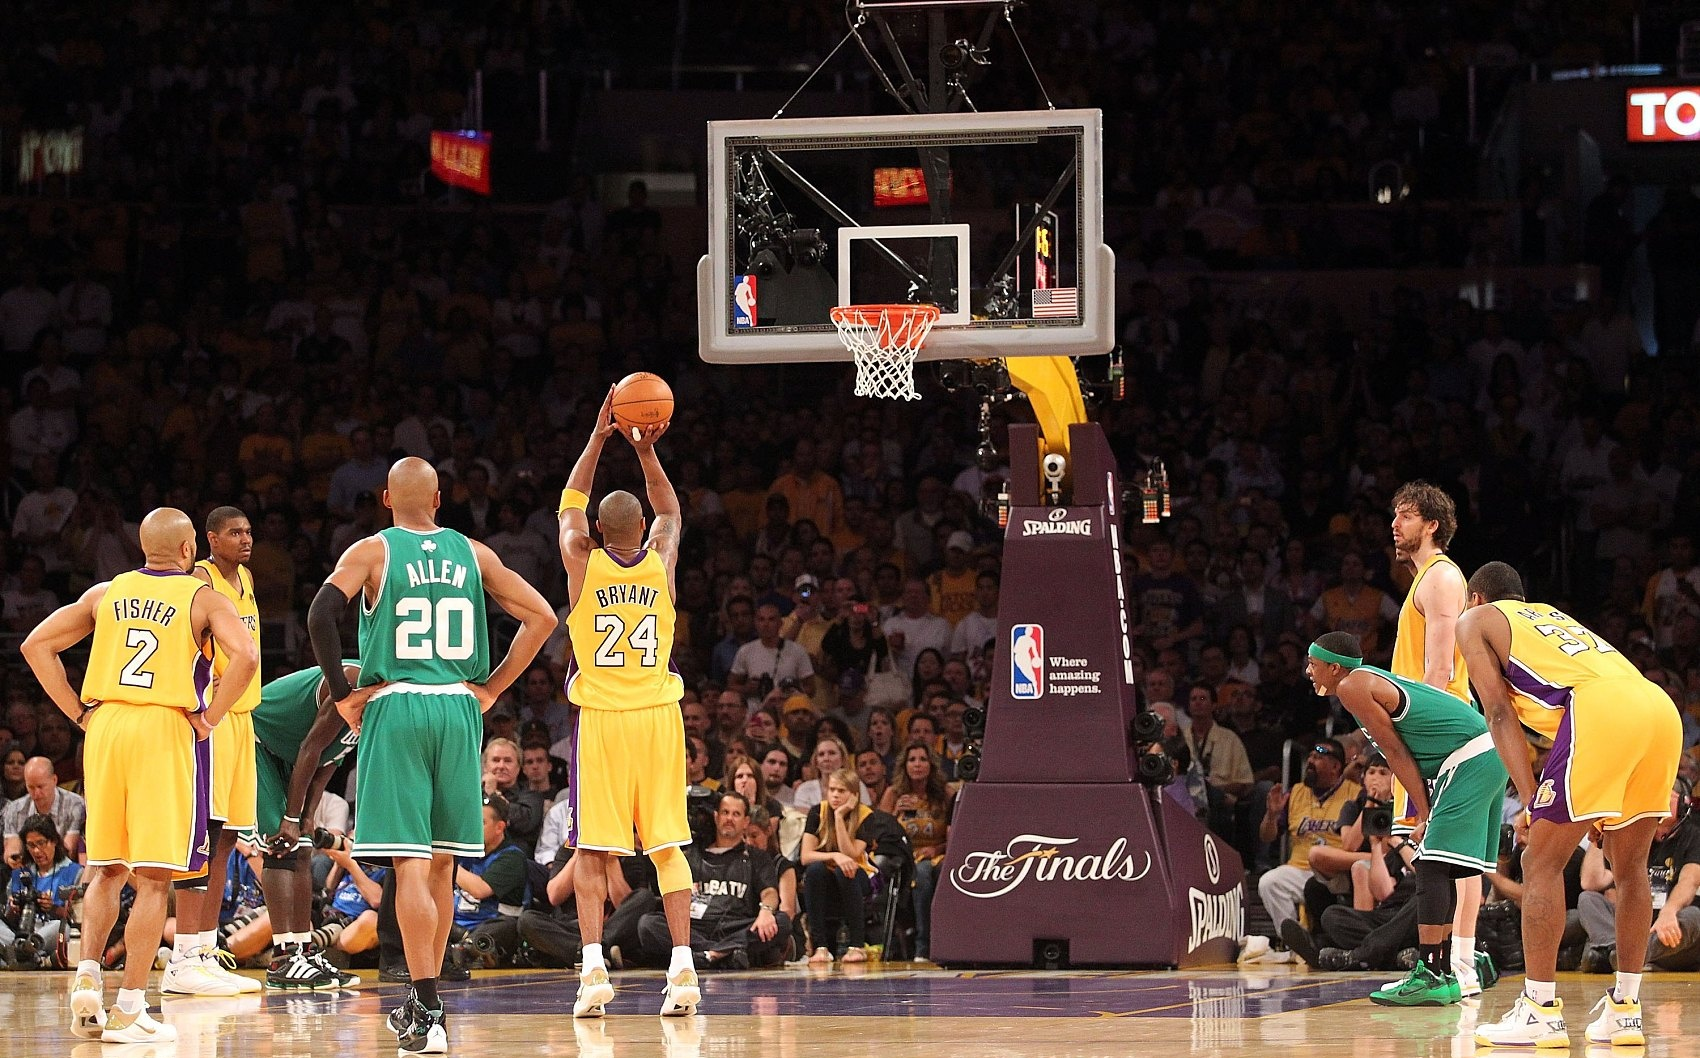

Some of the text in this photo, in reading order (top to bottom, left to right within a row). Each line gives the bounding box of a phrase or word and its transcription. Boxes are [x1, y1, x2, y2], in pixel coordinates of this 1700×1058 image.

[1022, 519, 1092, 537] SPALDING
[405, 559, 468, 589] ALLEN
[595, 584, 659, 608] BRYANT
[113, 598, 177, 627] FISHER
[395, 597, 475, 660] 20
[594, 614, 659, 668] 24
[1534, 624, 1617, 657] 37
[118, 627, 159, 690] 2
[1049, 656, 1088, 668] Where
[1014, 682, 1034, 695] NBA
[1049, 669, 1102, 682] amazing
[1049, 683, 1102, 696] happens.
[958, 834, 1152, 892] The Finals
[1187, 881, 1245, 954] SPALDING
